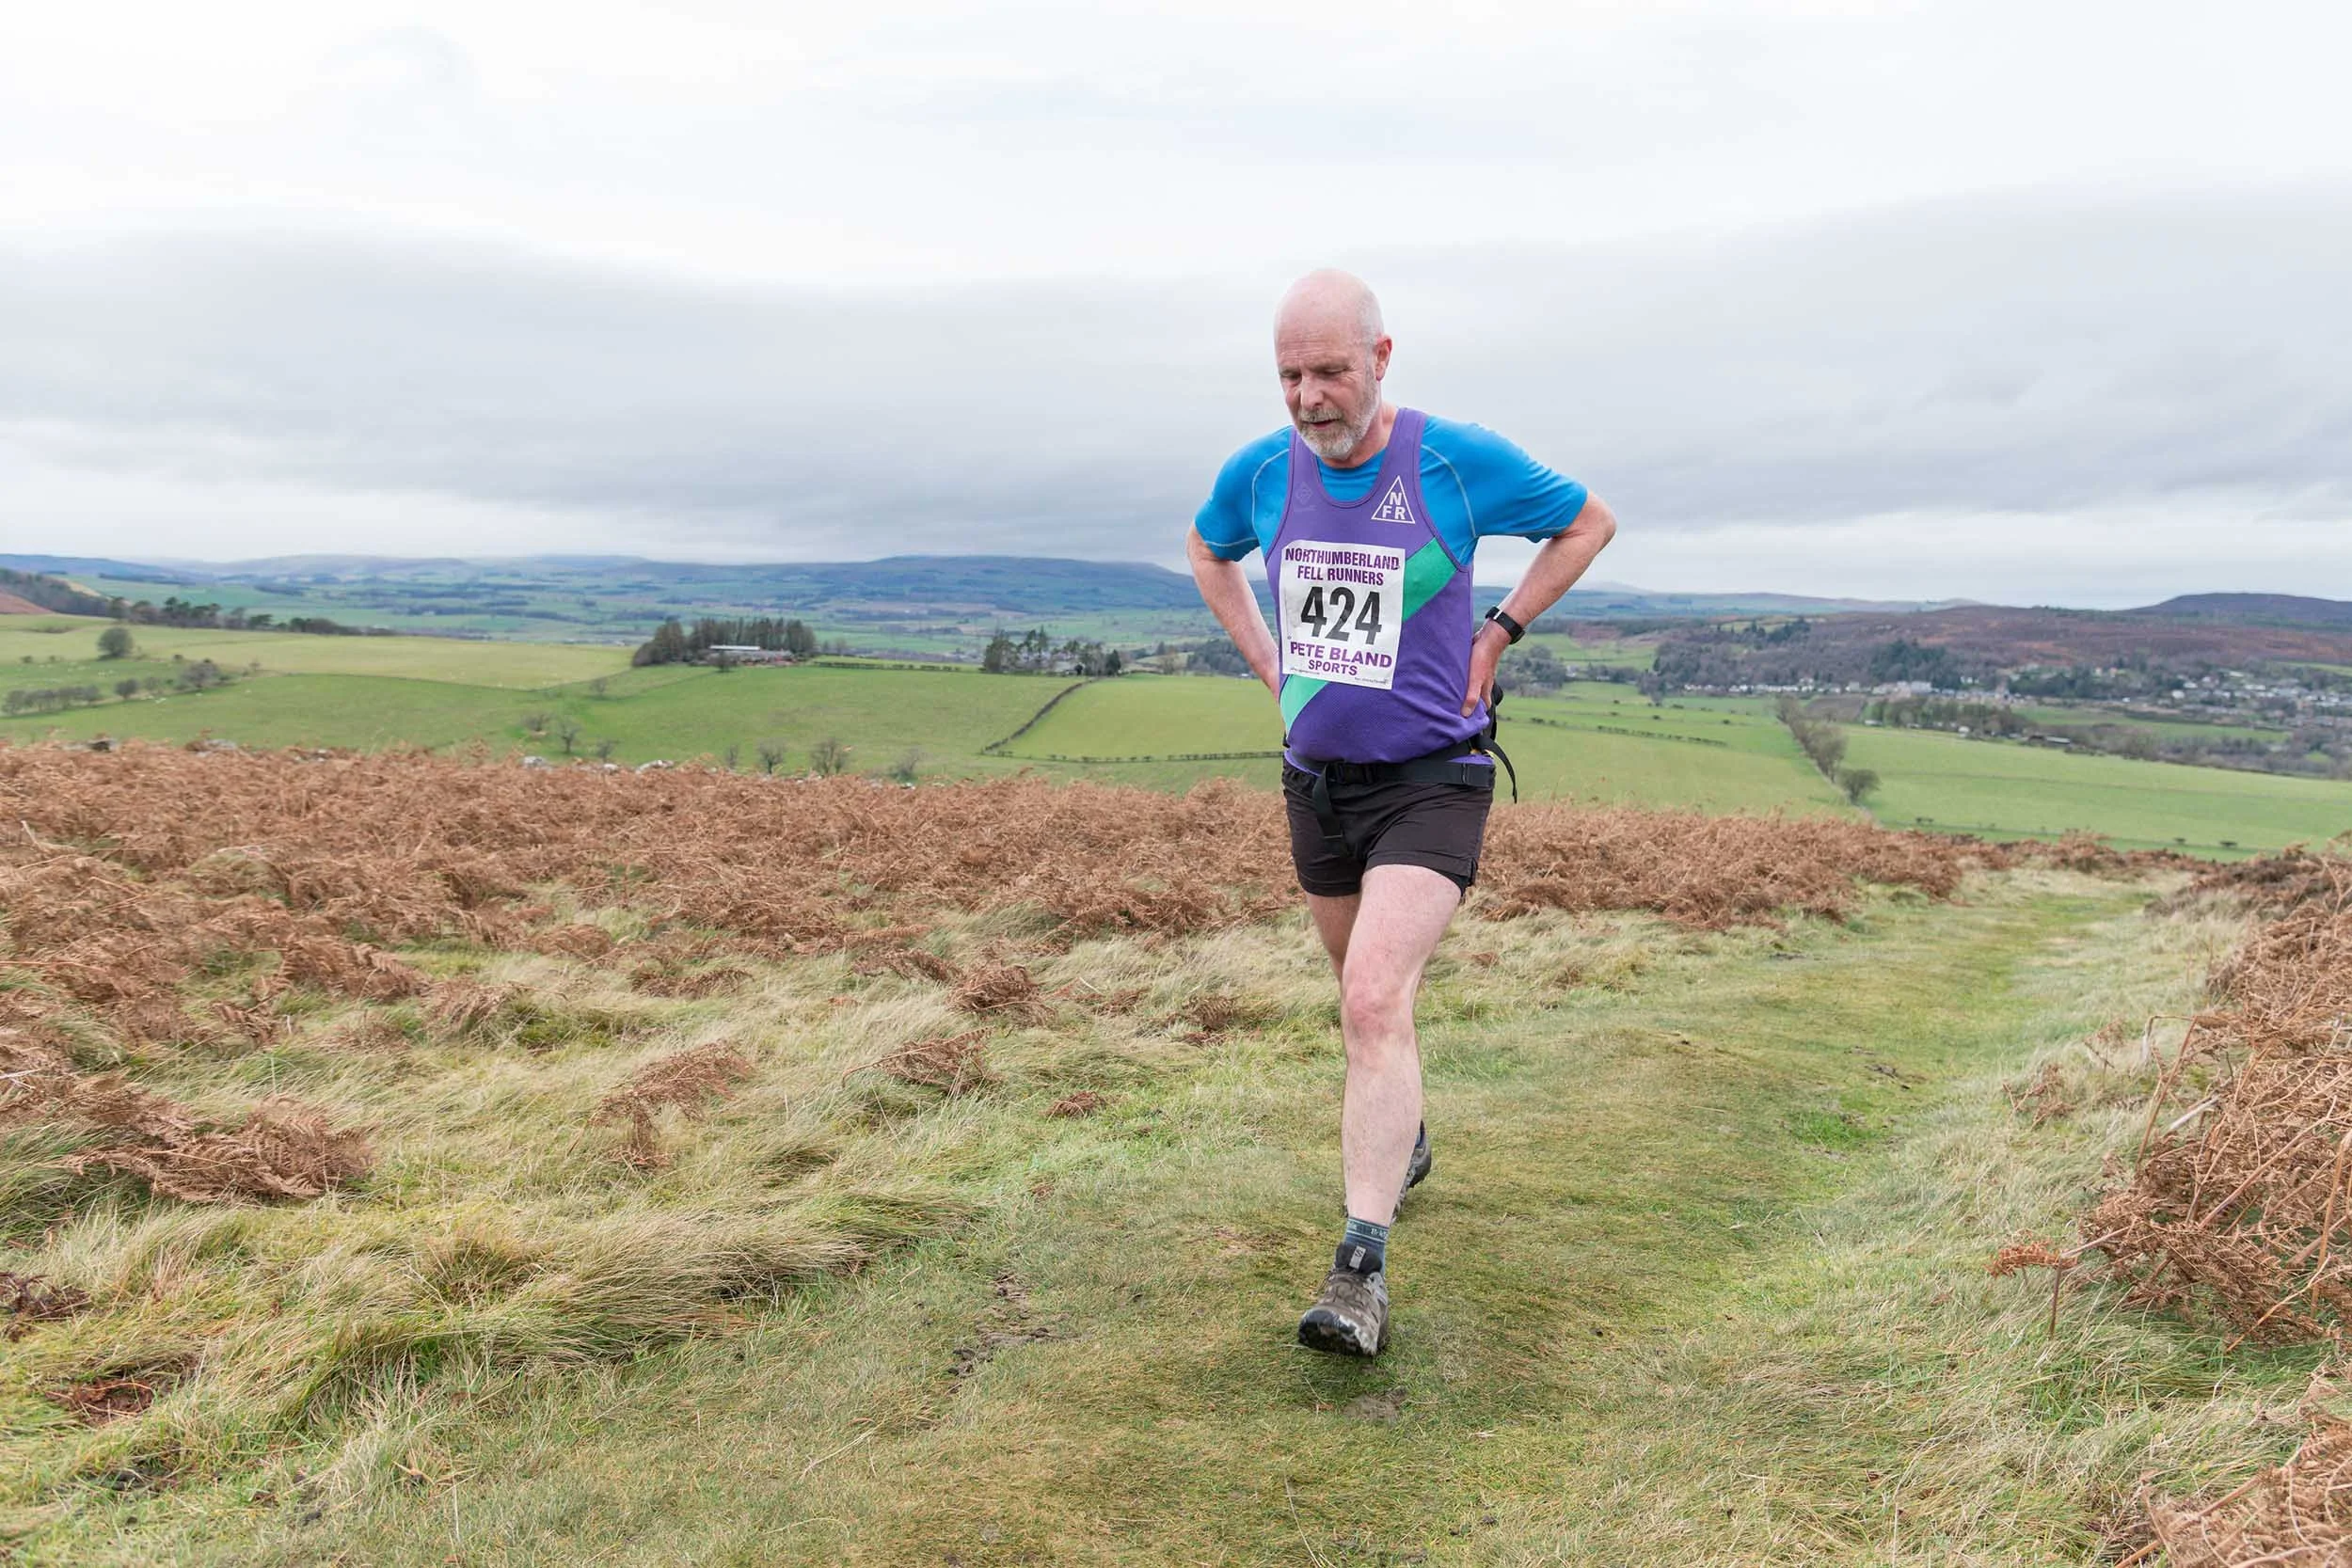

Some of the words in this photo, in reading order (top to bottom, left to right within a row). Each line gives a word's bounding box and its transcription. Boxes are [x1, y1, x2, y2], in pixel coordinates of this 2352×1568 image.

[1390, 492, 1402, 505] N
[1285, 547, 1400, 571] NORTHUMBERLAND
[1297, 565, 1324, 580] FELL
[1327, 568, 1384, 586] RUNNERS
[1300, 586, 1382, 645] 424
[1290, 641, 1325, 658] PETE
[1329, 647, 1392, 668] BLAND
[1309, 659, 1358, 676] SPORTS
